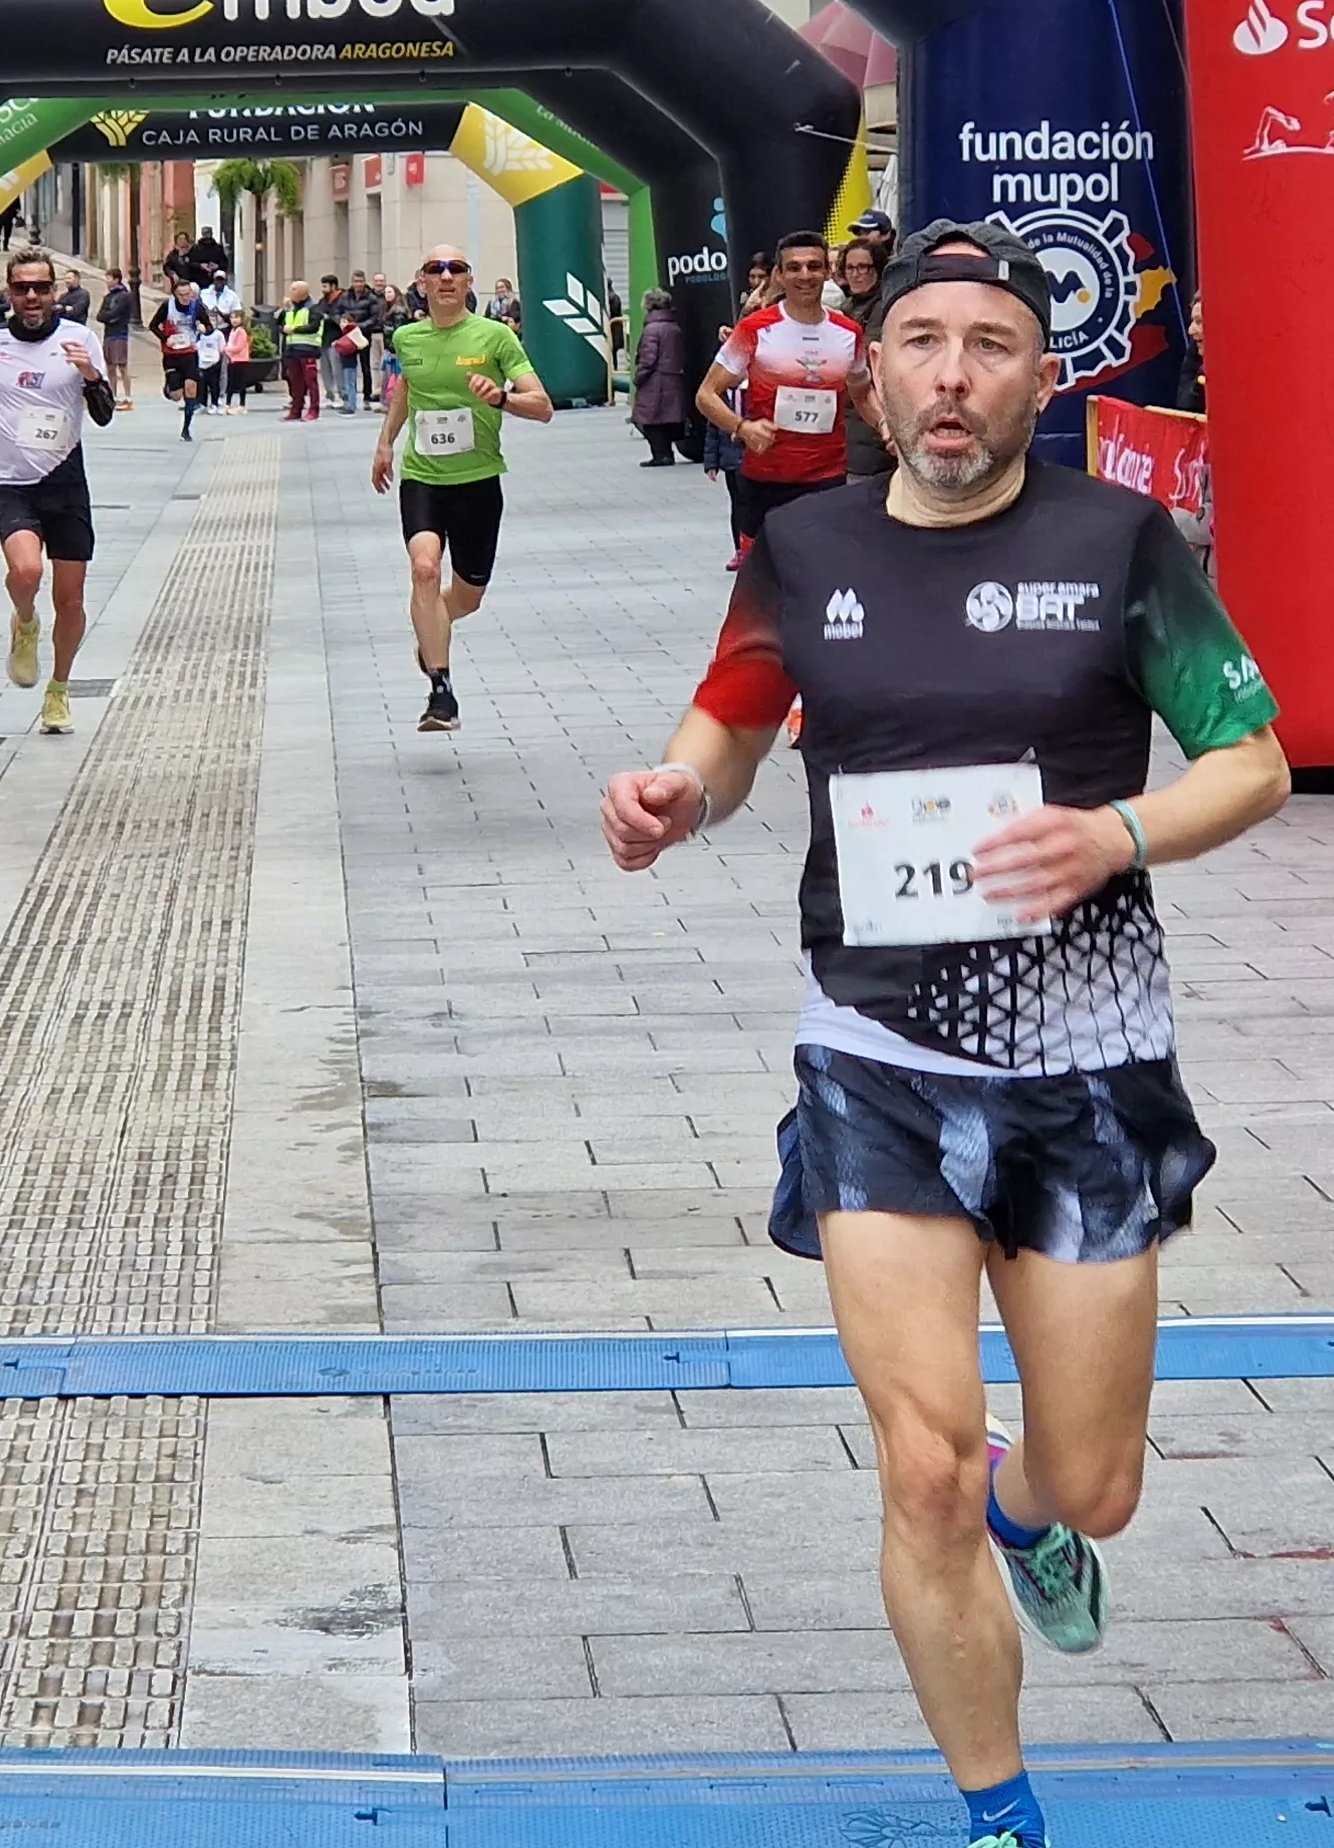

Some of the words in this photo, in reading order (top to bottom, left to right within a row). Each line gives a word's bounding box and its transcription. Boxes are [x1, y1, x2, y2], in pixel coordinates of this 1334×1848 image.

[106, 45, 173, 65] PÁSATE
[176, 49, 190, 64] A
[194, 48, 216, 63] LA
[220, 45, 337, 62] OPERADORA
[339, 41, 454, 60] ARAGONESA
[142, 127, 200, 146] CAJA
[208, 123, 282, 144] RURAL
[290, 124, 320, 140] DE
[328, 117, 423, 138] ARAGÓN
[959, 120, 1154, 161] fundación
[992, 163, 1119, 209] mupol
[667, 245, 727, 287] podo
[1043, 233, 1054, 243] la
[1056, 231, 1109, 269] Mutualidad
[1103, 271, 1113, 285] de
[1049, 331, 1089, 349] LICÍA
[795, 410, 819, 423] 577
[35, 428, 58, 440] 267
[430, 432, 455, 444] 636
[1016, 593, 1085, 621] BAT
[894, 857, 974, 900] 219
